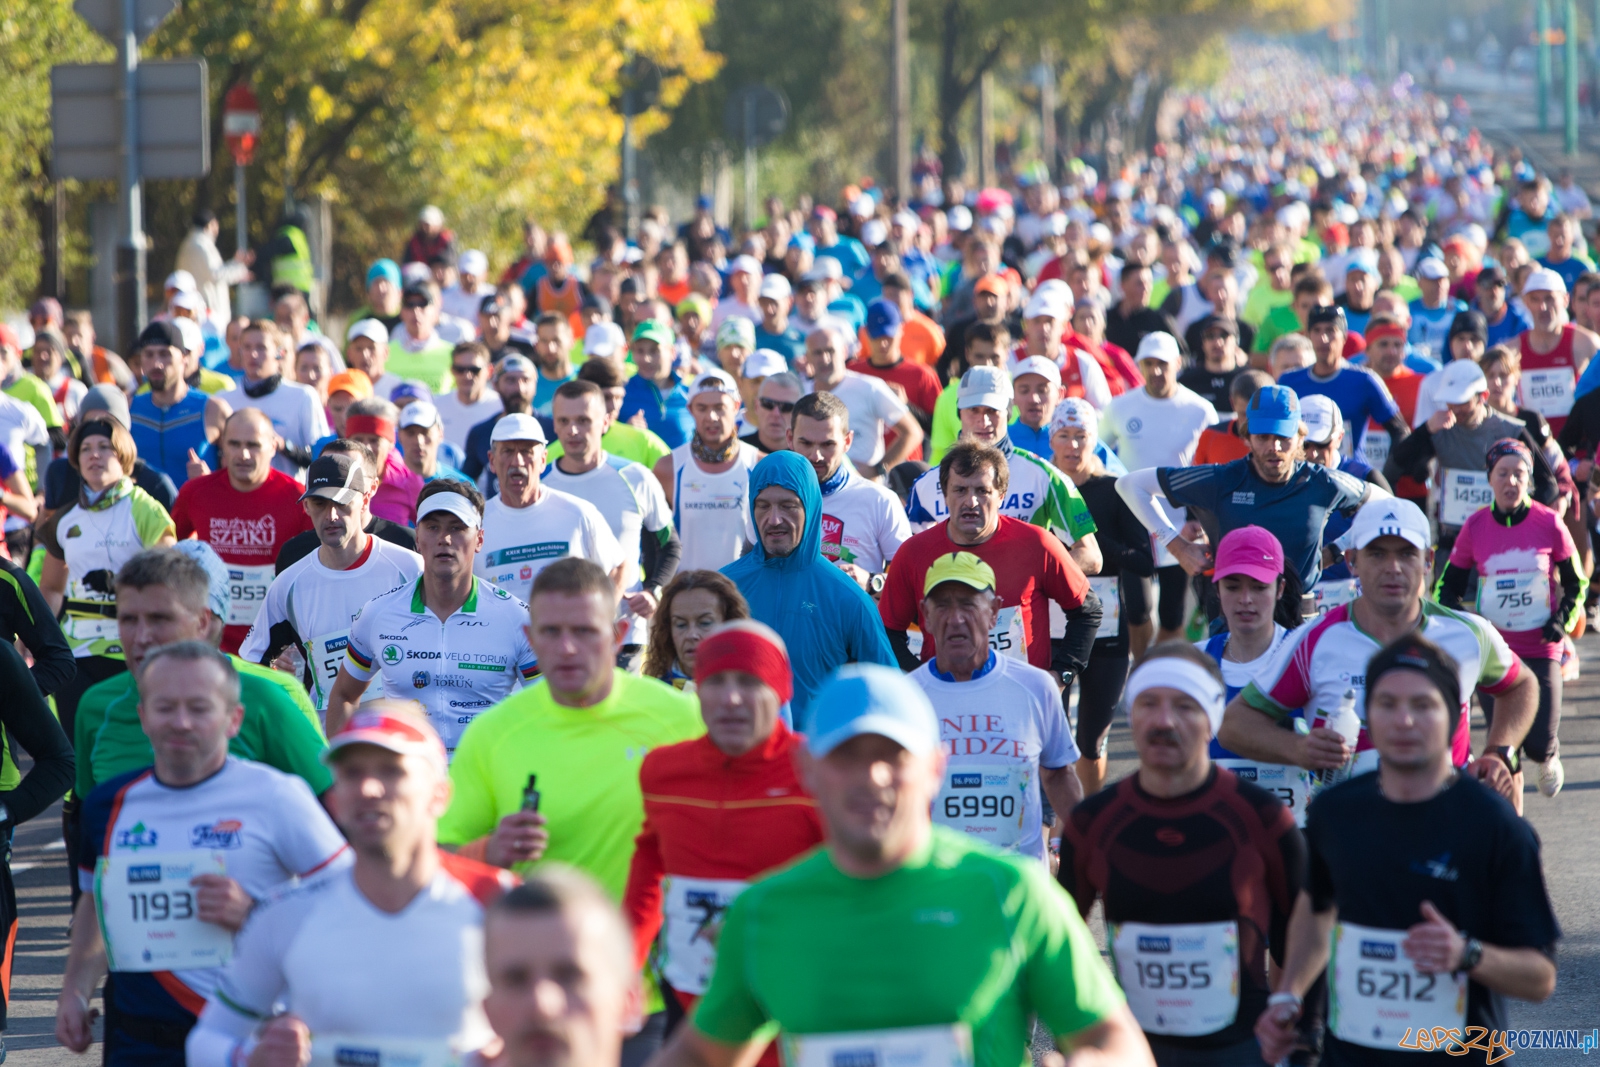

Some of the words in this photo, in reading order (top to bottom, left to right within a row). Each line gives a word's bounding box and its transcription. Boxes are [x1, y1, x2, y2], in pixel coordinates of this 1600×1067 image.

[999, 493, 1035, 510] AS
[1454, 487, 1492, 504] 1458
[209, 517, 263, 529] DRUŻYNA
[209, 529, 276, 546] SZPIKU
[231, 585, 267, 600] 953
[1497, 591, 1533, 609] 756
[327, 638, 348, 650] 16.PKO
[406, 650, 441, 660] ŠKODA
[443, 652, 471, 661] VELO
[473, 653, 508, 665] TORUŃ
[433, 678, 473, 688] TORUŃ
[941, 714, 1004, 733] NIE
[942, 737, 1029, 762] IDZĘ
[953, 776, 980, 786] 16.PKO
[1271, 788, 1294, 807] 3
[944, 795, 1015, 818] 6990
[964, 825, 997, 833] Zbigniew
[128, 891, 193, 921] 1193
[1135, 961, 1211, 989] 1955
[1357, 966, 1437, 1003] 6212
